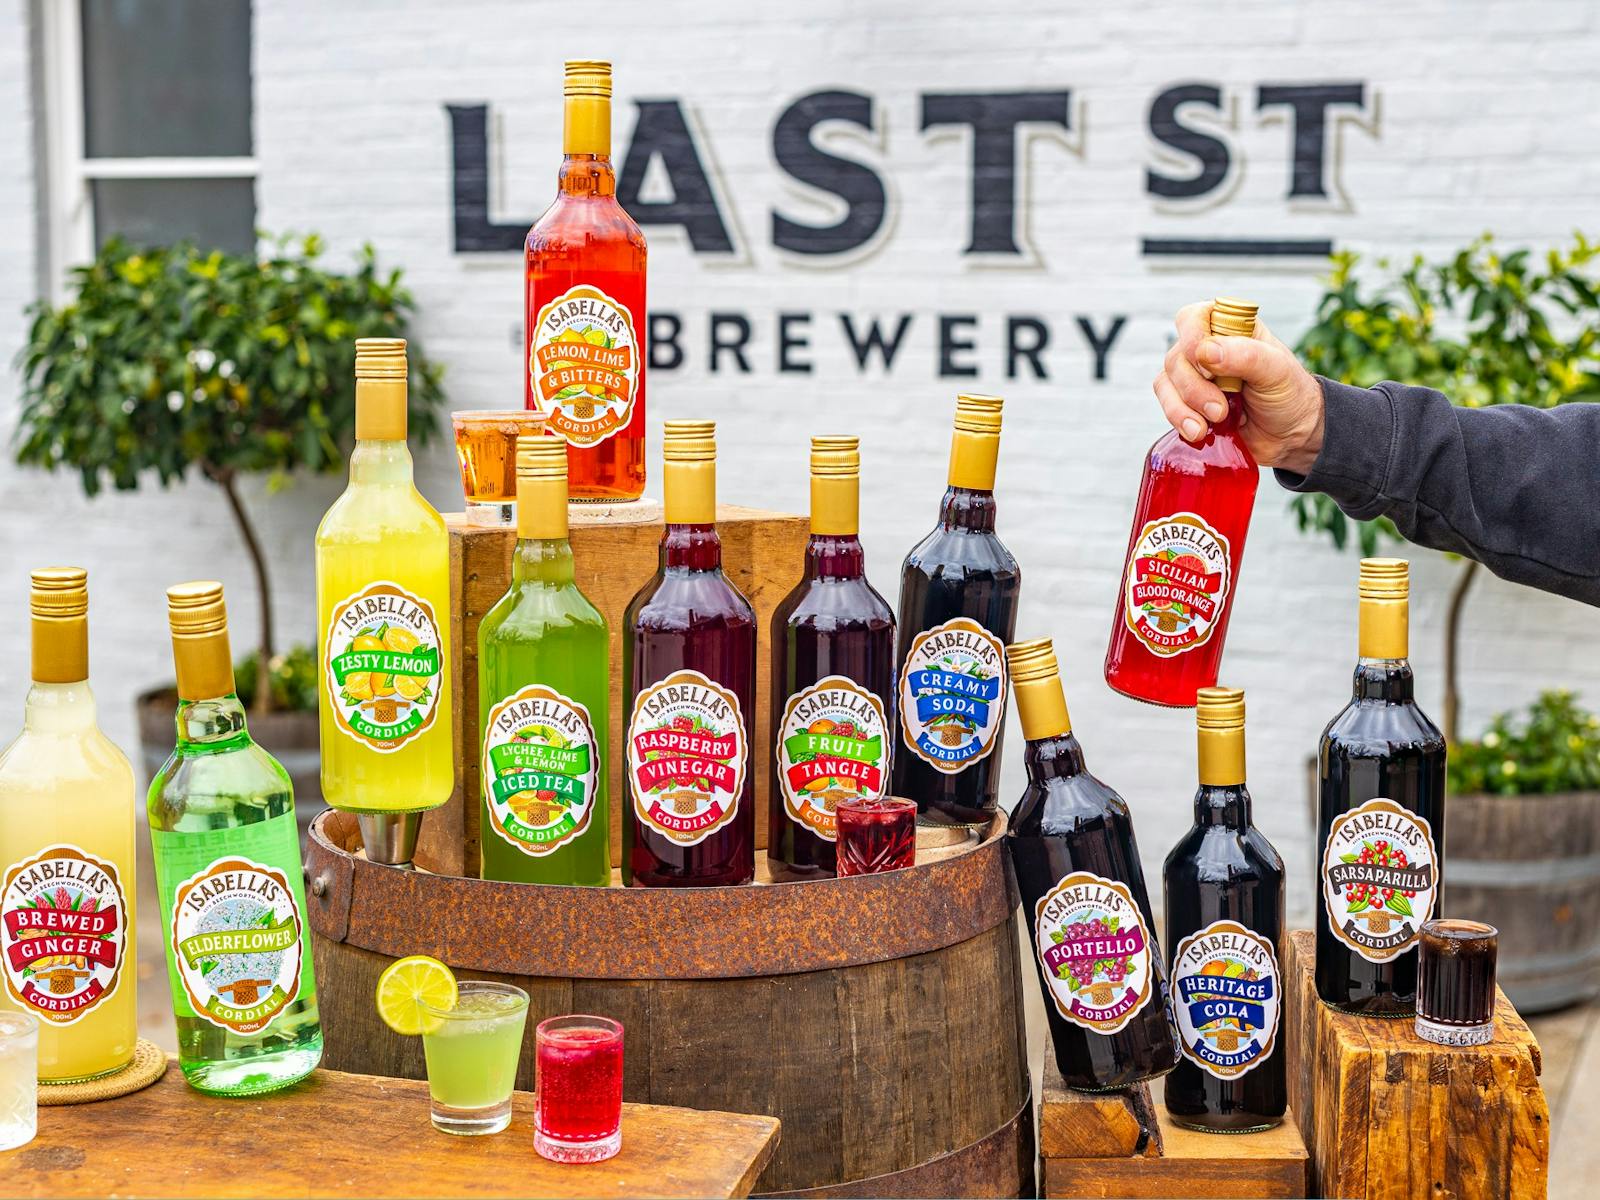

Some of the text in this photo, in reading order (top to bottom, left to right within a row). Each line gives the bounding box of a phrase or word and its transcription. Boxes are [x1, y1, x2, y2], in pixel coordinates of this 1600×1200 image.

[444, 82, 1366, 257] LAST ST
[545, 300, 624, 333] ISABELLA'S
[543, 345, 624, 366] LEMON, LIME
[647, 311, 1129, 381] BREWERY
[549, 370, 621, 388] & BITTERS
[557, 418, 612, 432] CORDIAL
[1148, 526, 1220, 560] ISABELLA'S
[1149, 561, 1208, 590] SICILIAN
[1137, 585, 1211, 613] BLOOD ORANGE
[341, 597, 426, 629] ISABELLA'S
[364, 616, 404, 625] BEECHWORTH
[1141, 626, 1191, 645] CORDIAL
[921, 632, 996, 665] ISABELLA'S
[339, 655, 432, 673] ZESTY LEMON
[921, 673, 990, 696] CREAMY
[644, 686, 729, 720] ISABELLA'S
[667, 705, 706, 714] BEECHWORTH
[795, 692, 875, 723] ISABELLA'S
[933, 699, 975, 714] SODA
[497, 701, 581, 734] ISABELLA'S
[357, 721, 416, 737] CORDIAL
[502, 745, 577, 762] LYCHEE, LIME
[639, 734, 731, 756] RASPBERRY
[809, 737, 865, 756] FRUIT
[923, 742, 975, 759] CORDIAL
[514, 756, 565, 770] & LEMON
[646, 760, 726, 780] VINEGAR
[802, 762, 870, 779] TANGLE
[502, 775, 574, 793] ICED TEA
[656, 812, 715, 829] CORDIAL
[1339, 814, 1422, 846] ISABELLA'S
[510, 825, 568, 840] CORDIAL
[1362, 831, 1400, 840] BEECHWORTH
[14, 862, 108, 896] ISABELLA'S
[40, 882, 85, 891] BEECHWORTH
[1334, 867, 1427, 888] SARSAPARILLA
[186, 874, 279, 912] ISABELLA'S
[213, 893, 256, 905] BEECHWORTH
[1044, 886, 1124, 924] ISABELLA'S
[16, 912, 105, 931] BREWED
[22, 938, 102, 958] GINGER
[187, 930, 291, 955] ELDERFLOWER
[1350, 931, 1407, 948] CORDIAL
[1051, 938, 1136, 962] PORTELLO
[1187, 935, 1266, 965] ISABELLA'S
[1185, 978, 1265, 998] HERITAGE
[30, 992, 96, 1010] CORDIAL
[215, 1000, 279, 1020] CORDIAL
[1078, 1000, 1133, 1020] CORDIAL
[1204, 1003, 1248, 1018] COLA
[1200, 1049, 1255, 1065] CORDIAL
